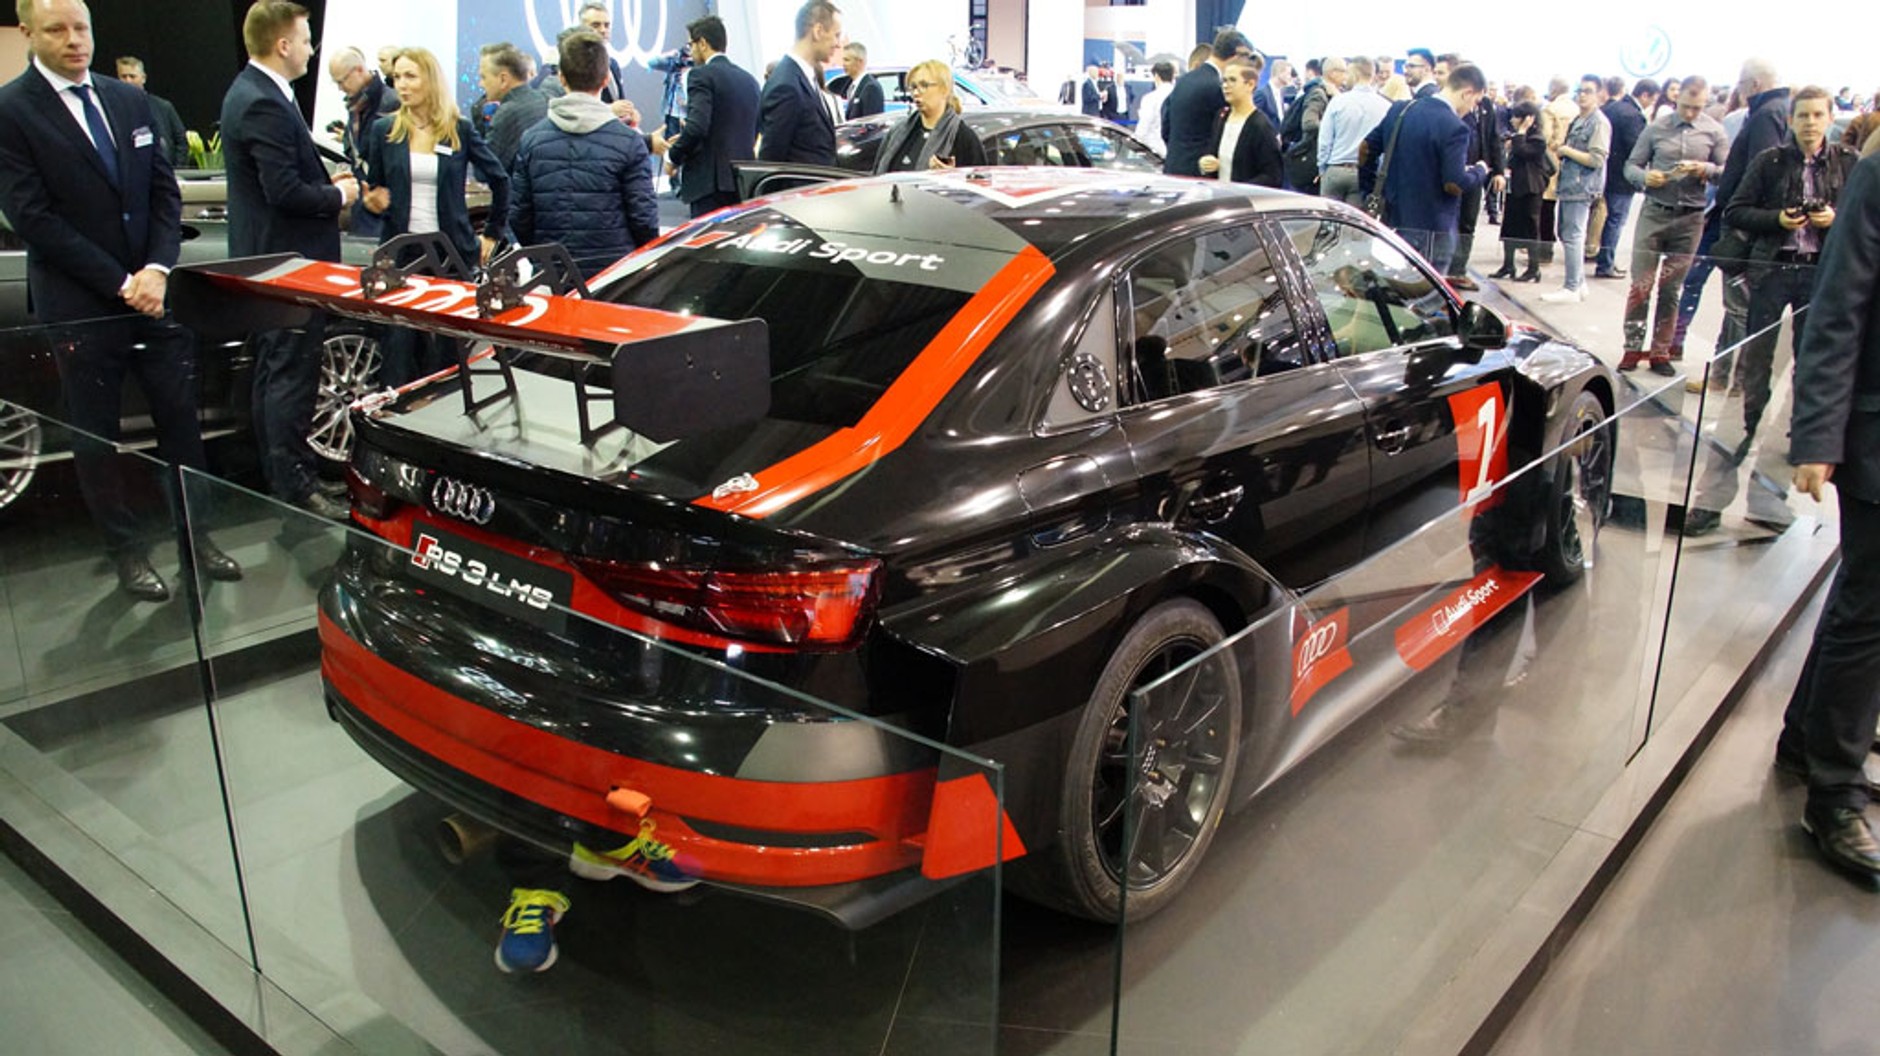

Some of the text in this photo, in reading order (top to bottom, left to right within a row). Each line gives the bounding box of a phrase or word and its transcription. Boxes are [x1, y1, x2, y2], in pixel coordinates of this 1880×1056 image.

[716, 234, 945, 270] Audi Sport
[1466, 396, 1494, 508] 1
[422, 544, 553, 610] RS 3 LMS
[1444, 578, 1500, 624] Audi Sport
